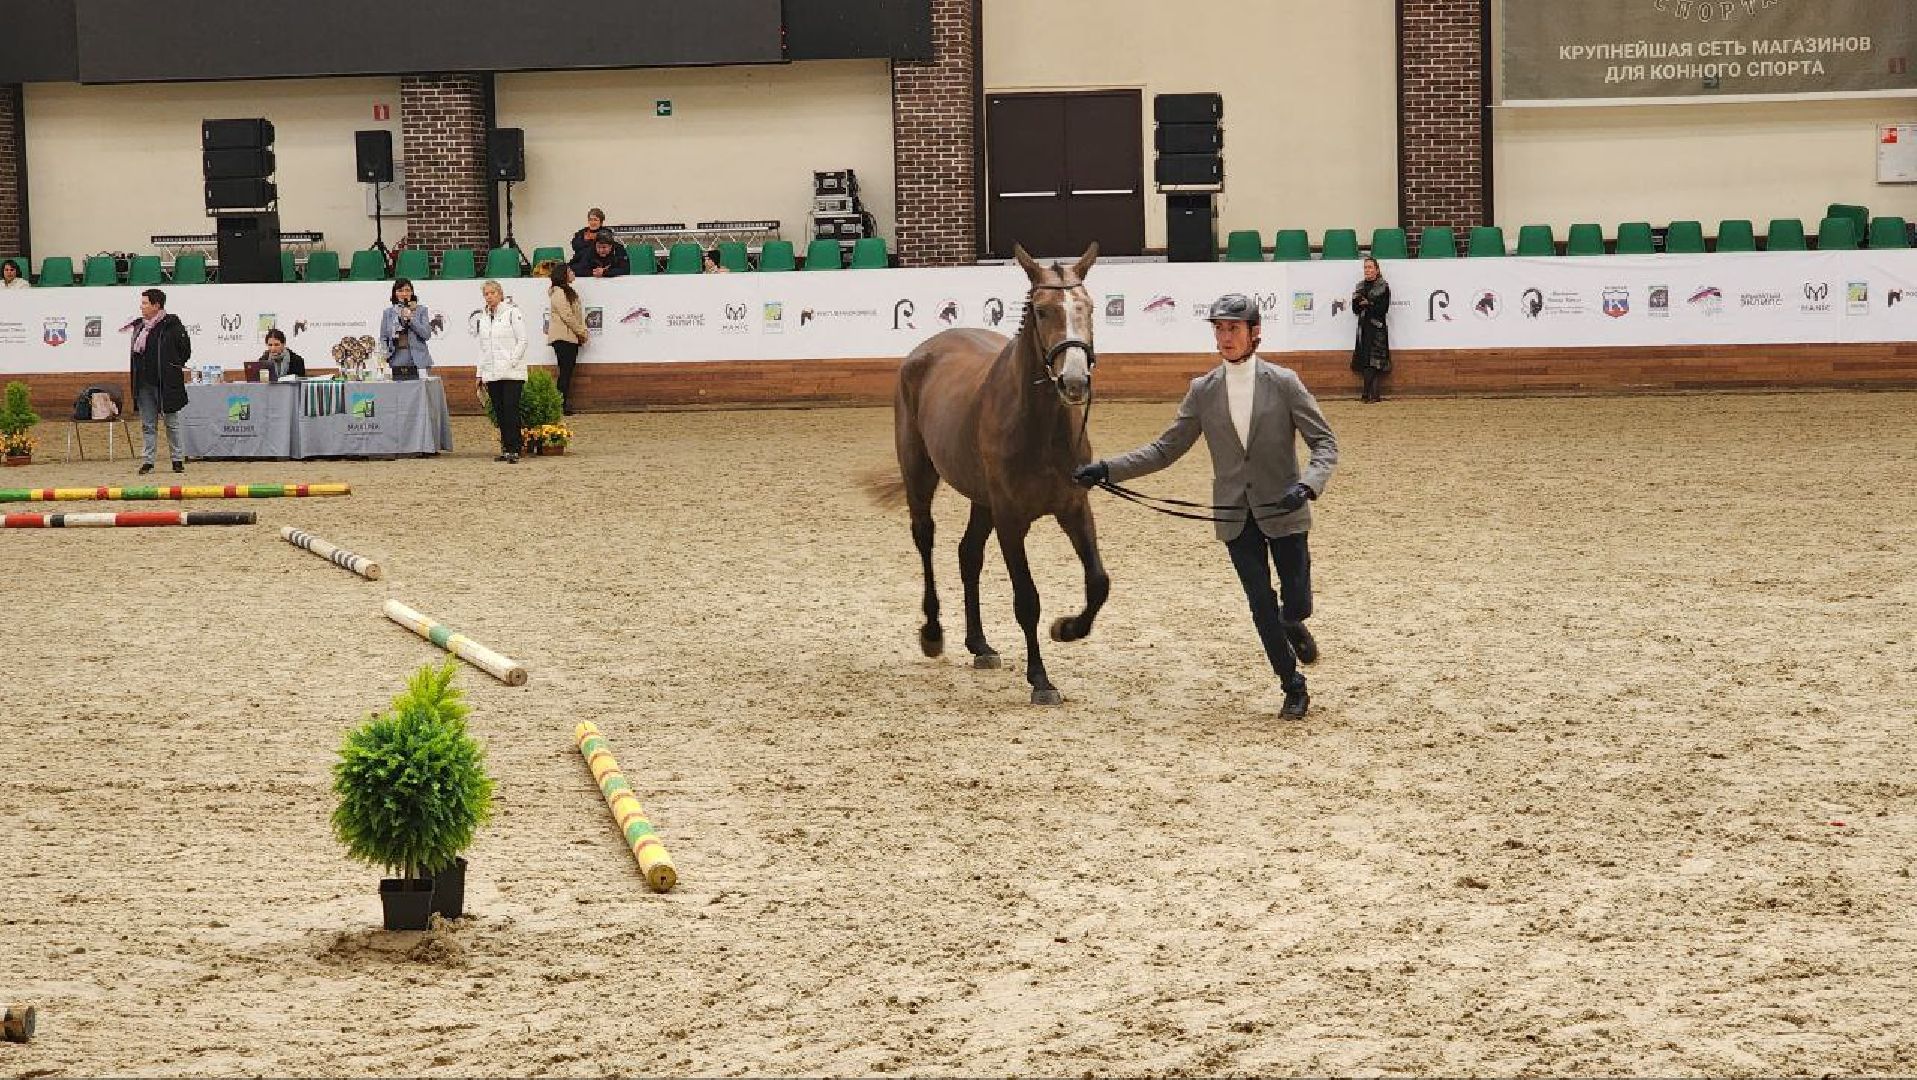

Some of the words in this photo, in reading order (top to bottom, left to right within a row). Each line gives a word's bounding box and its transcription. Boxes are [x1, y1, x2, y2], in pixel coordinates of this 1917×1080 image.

[1559, 41, 1692, 60] КРУПНЕЙШАЯ
[1698, 41, 1747, 56] СЕТЬ
[1752, 37, 1871, 54] МАГАЗИНОВ
[1604, 65, 1645, 83] ДЛЯ
[1650, 63, 1740, 80] КОННОГО
[1746, 61, 1825, 77] СПОРТА
